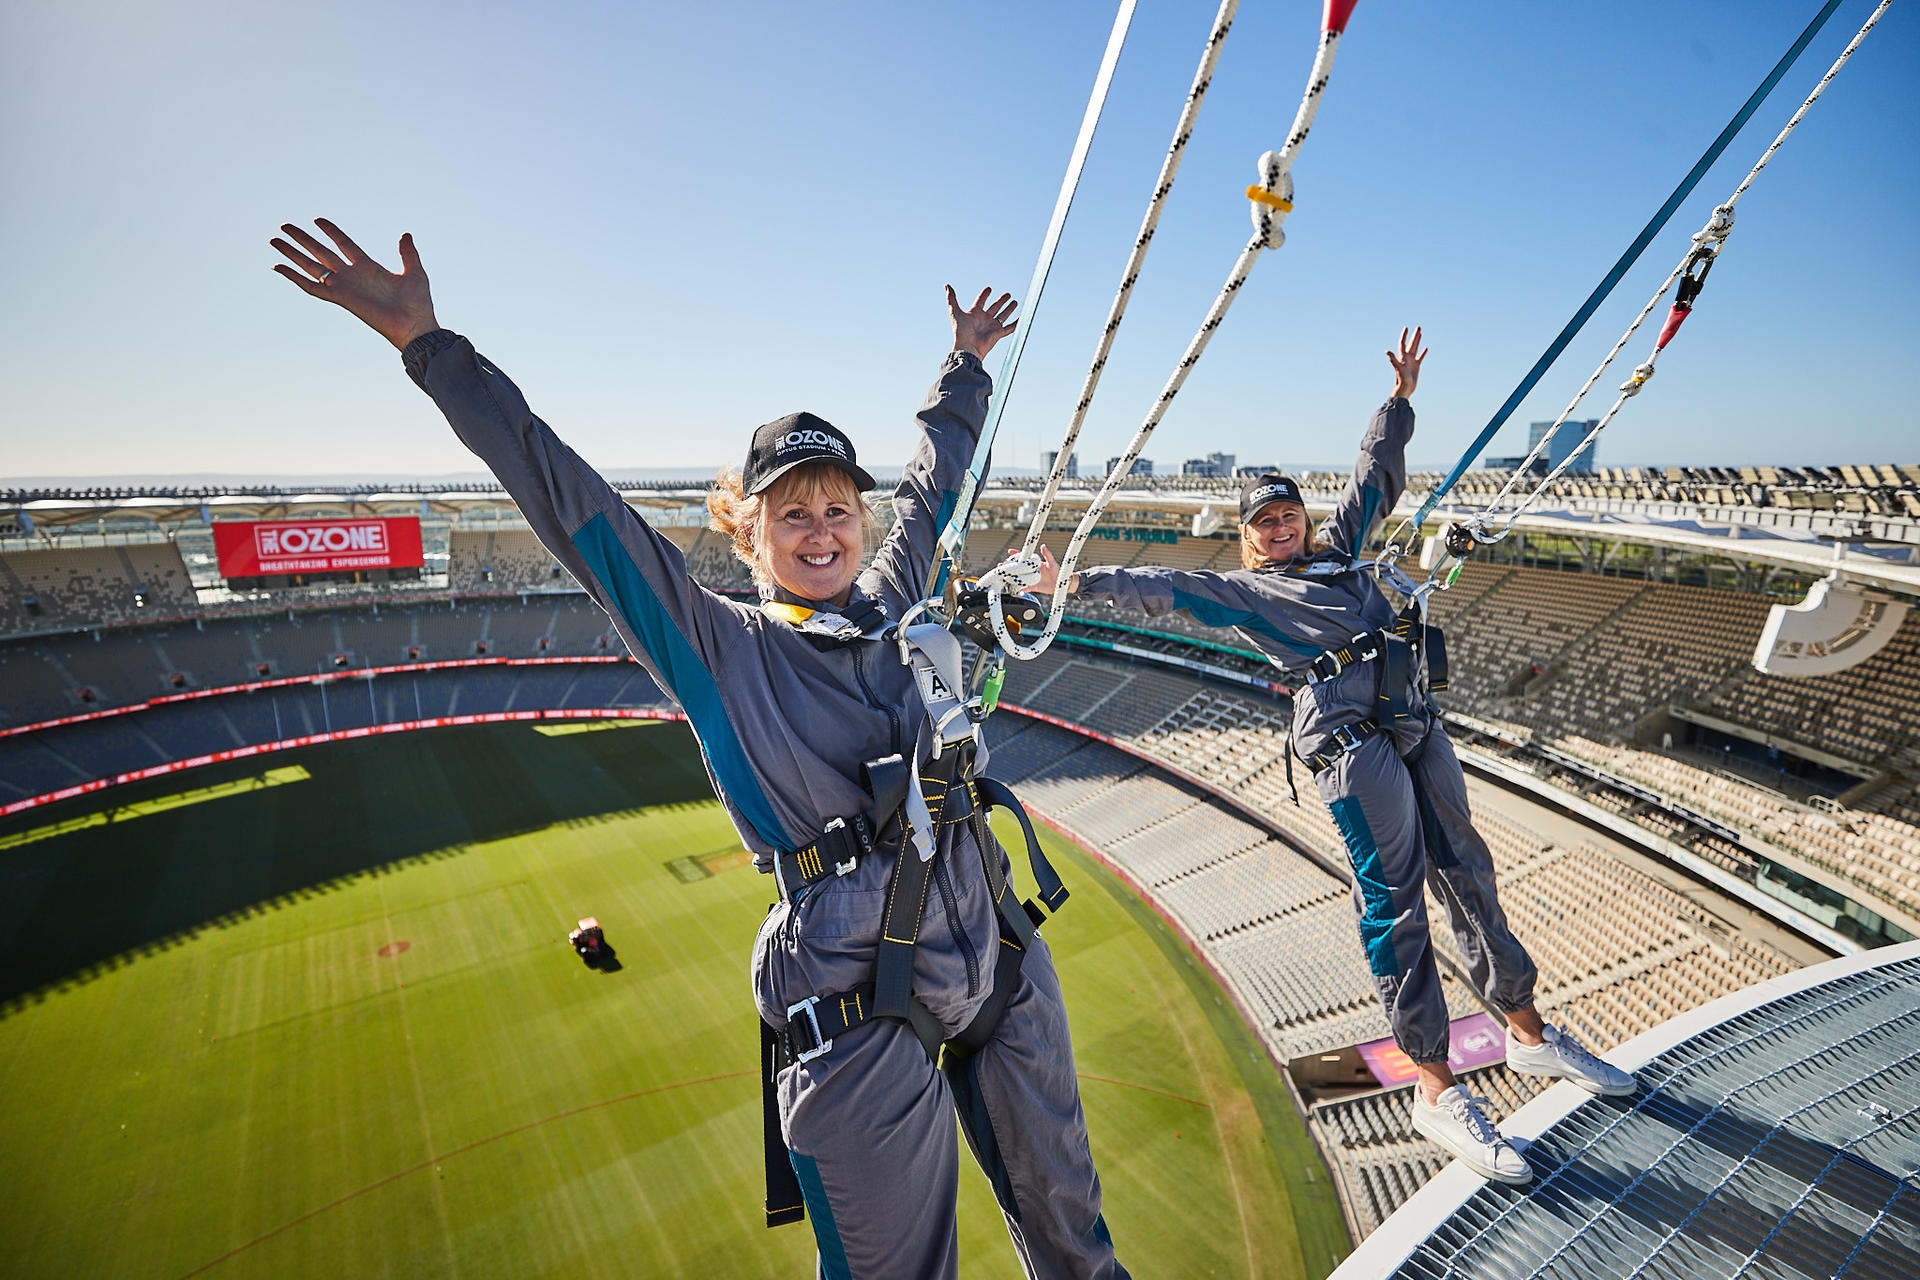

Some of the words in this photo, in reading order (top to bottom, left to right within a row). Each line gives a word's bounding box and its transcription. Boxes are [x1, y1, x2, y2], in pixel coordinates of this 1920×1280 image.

[777, 446, 797, 456] OPTUS
[785, 429, 847, 455] OZONE
[1254, 483, 1289, 498] OZONE
[261, 530, 280, 554] THE
[280, 526, 384, 553] OZONE
[1088, 527, 1120, 541] PTUS
[1124, 528, 1178, 545] STADIUM
[932, 675, 947, 695] A
